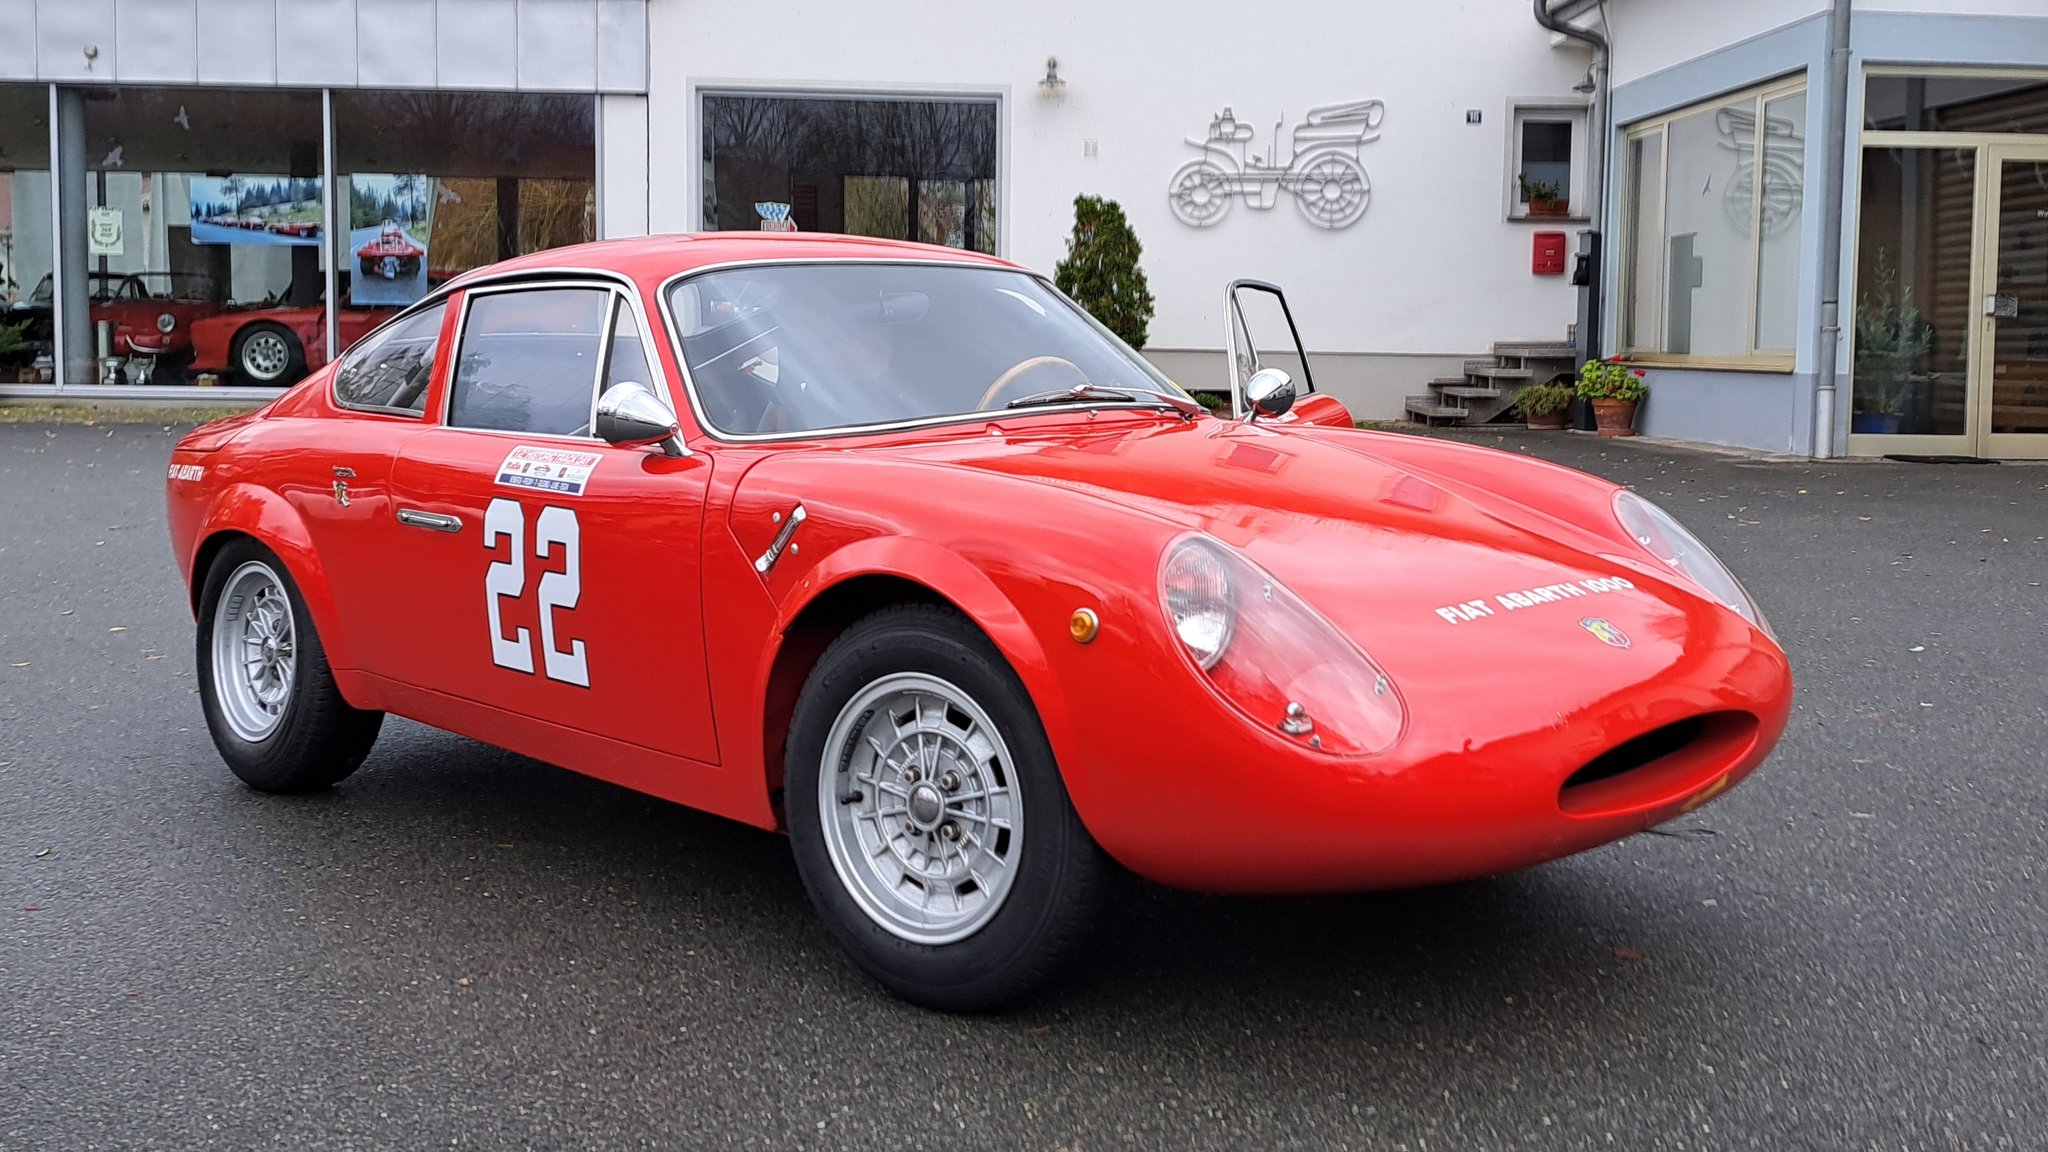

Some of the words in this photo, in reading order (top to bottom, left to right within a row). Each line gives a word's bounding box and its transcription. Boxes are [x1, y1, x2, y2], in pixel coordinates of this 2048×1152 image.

[483, 497, 590, 689] 22
[1435, 600, 1495, 625] FIAT
[1495, 582, 1587, 611] ABARTH
[1579, 576, 1634, 593] 1000
